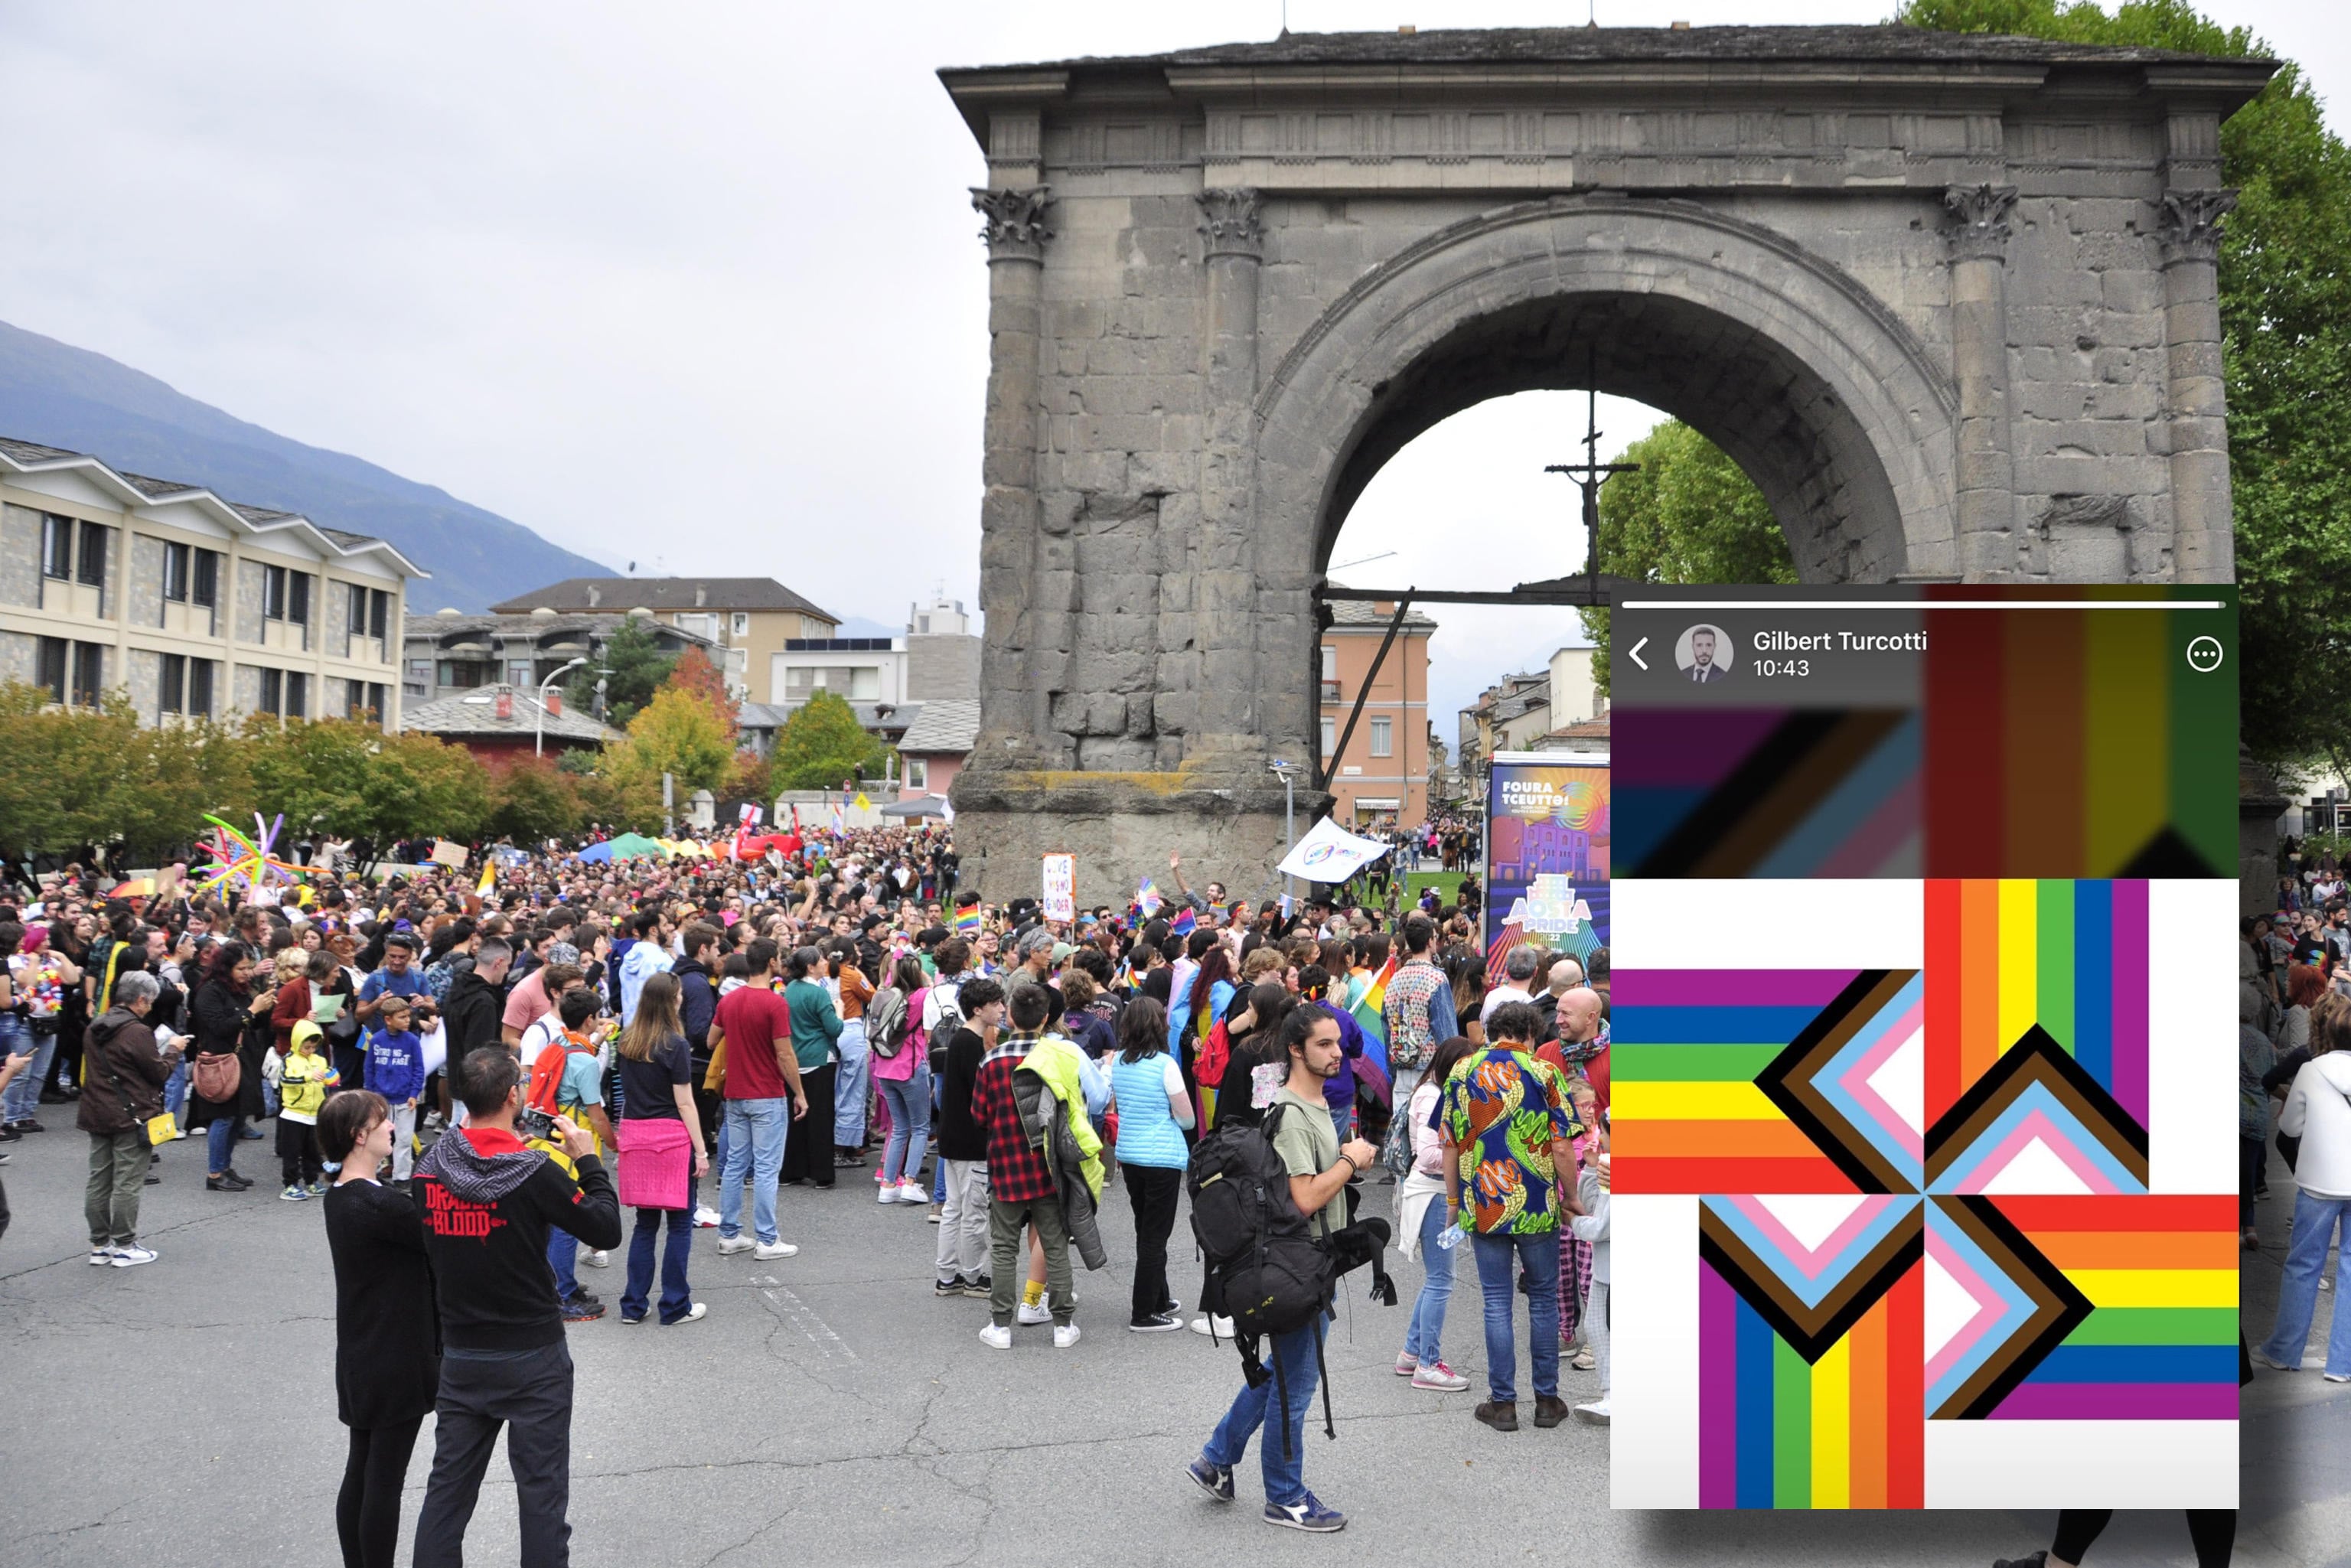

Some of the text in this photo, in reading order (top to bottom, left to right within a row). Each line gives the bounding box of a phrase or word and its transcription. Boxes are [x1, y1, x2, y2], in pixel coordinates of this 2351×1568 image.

[1503, 781, 1554, 793] FOURA
[1508, 898, 1592, 920] AOSTA
[1524, 918, 1578, 933] PRIDE
[425, 1183, 497, 1210] DRA
[432, 1210, 491, 1237] BLOOD
